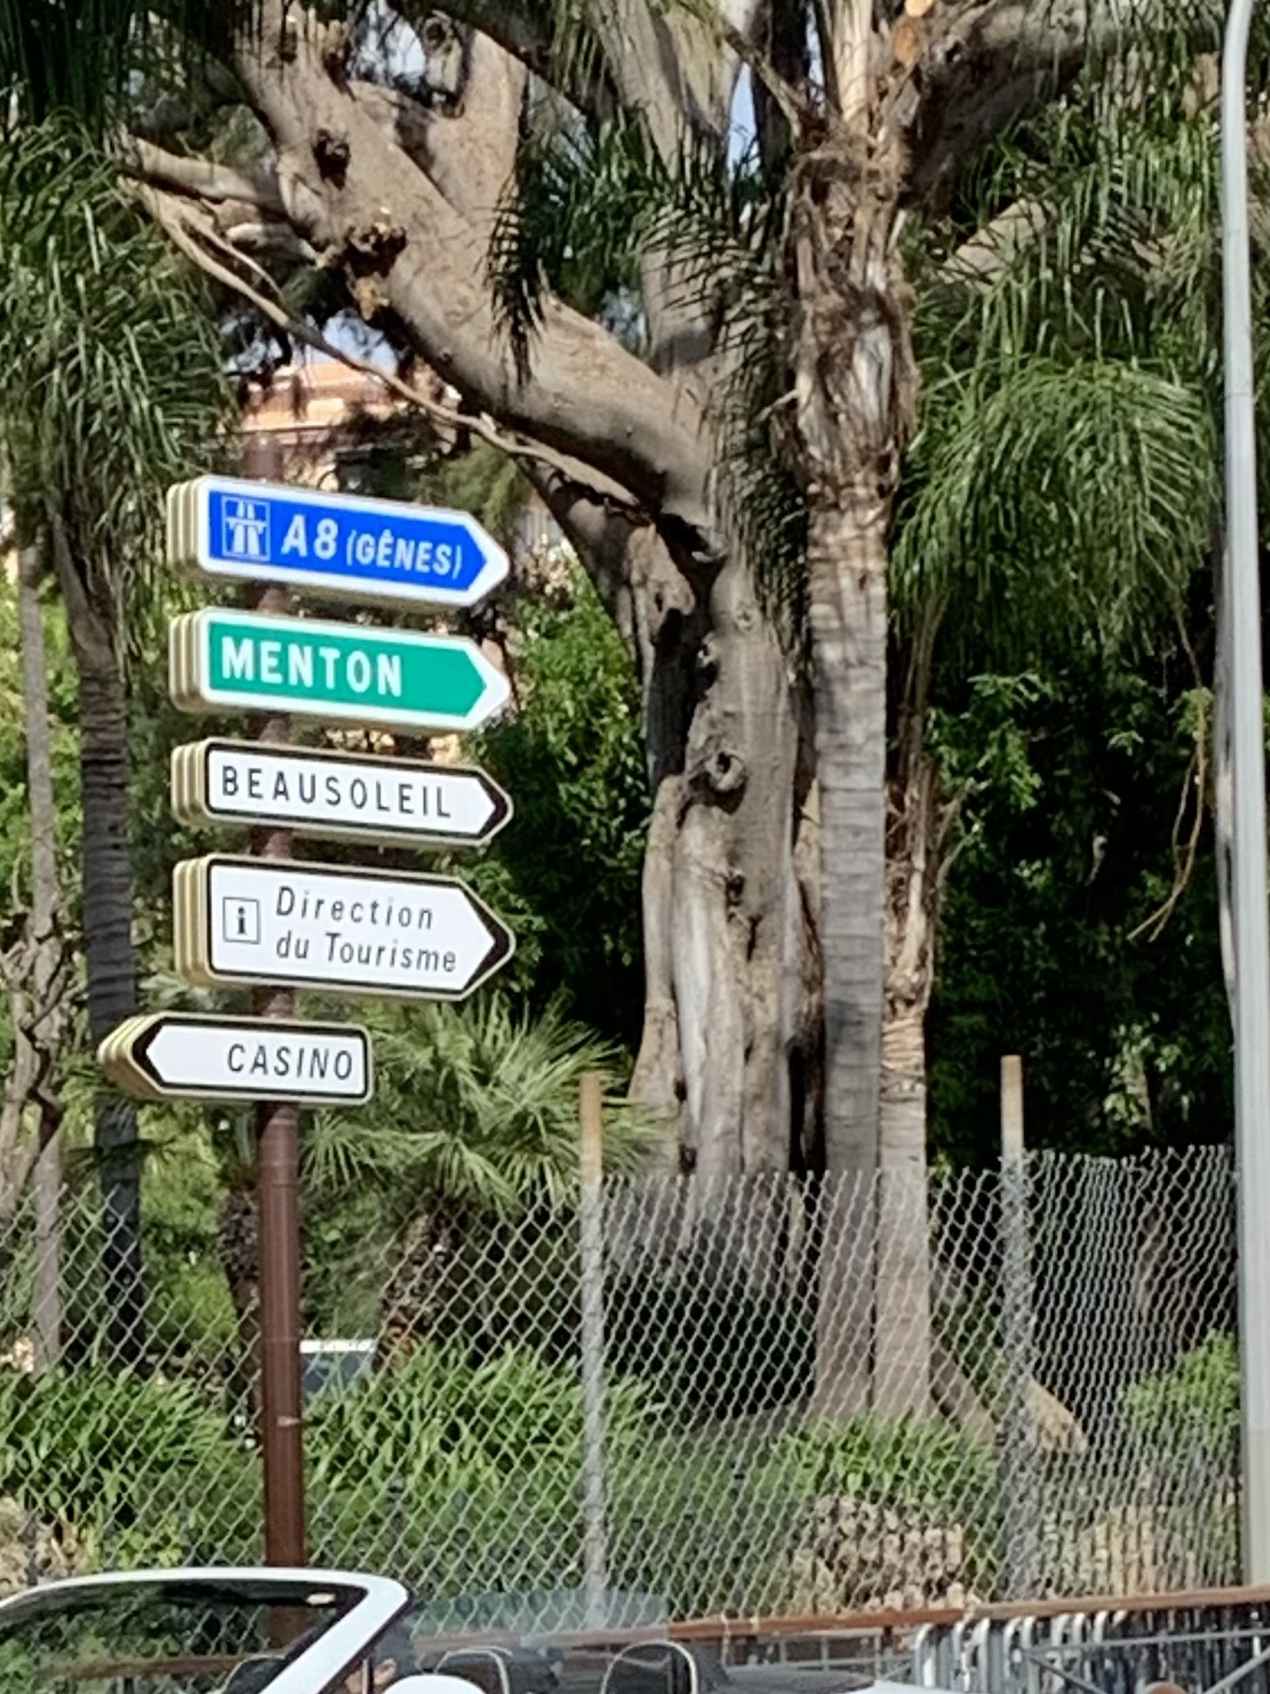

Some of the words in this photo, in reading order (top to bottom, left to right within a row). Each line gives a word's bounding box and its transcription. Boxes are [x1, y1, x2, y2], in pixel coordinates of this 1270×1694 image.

[281, 513, 339, 558] A8
[346, 529, 464, 579] (GÊNES)
[221, 636, 403, 698] MENTON
[222, 765, 452, 819] BEAUSOLEIL
[276, 885, 434, 930] Direction
[275, 930, 310, 960] du
[325, 932, 457, 973] Tourisme
[227, 1043, 353, 1081] CASINO
